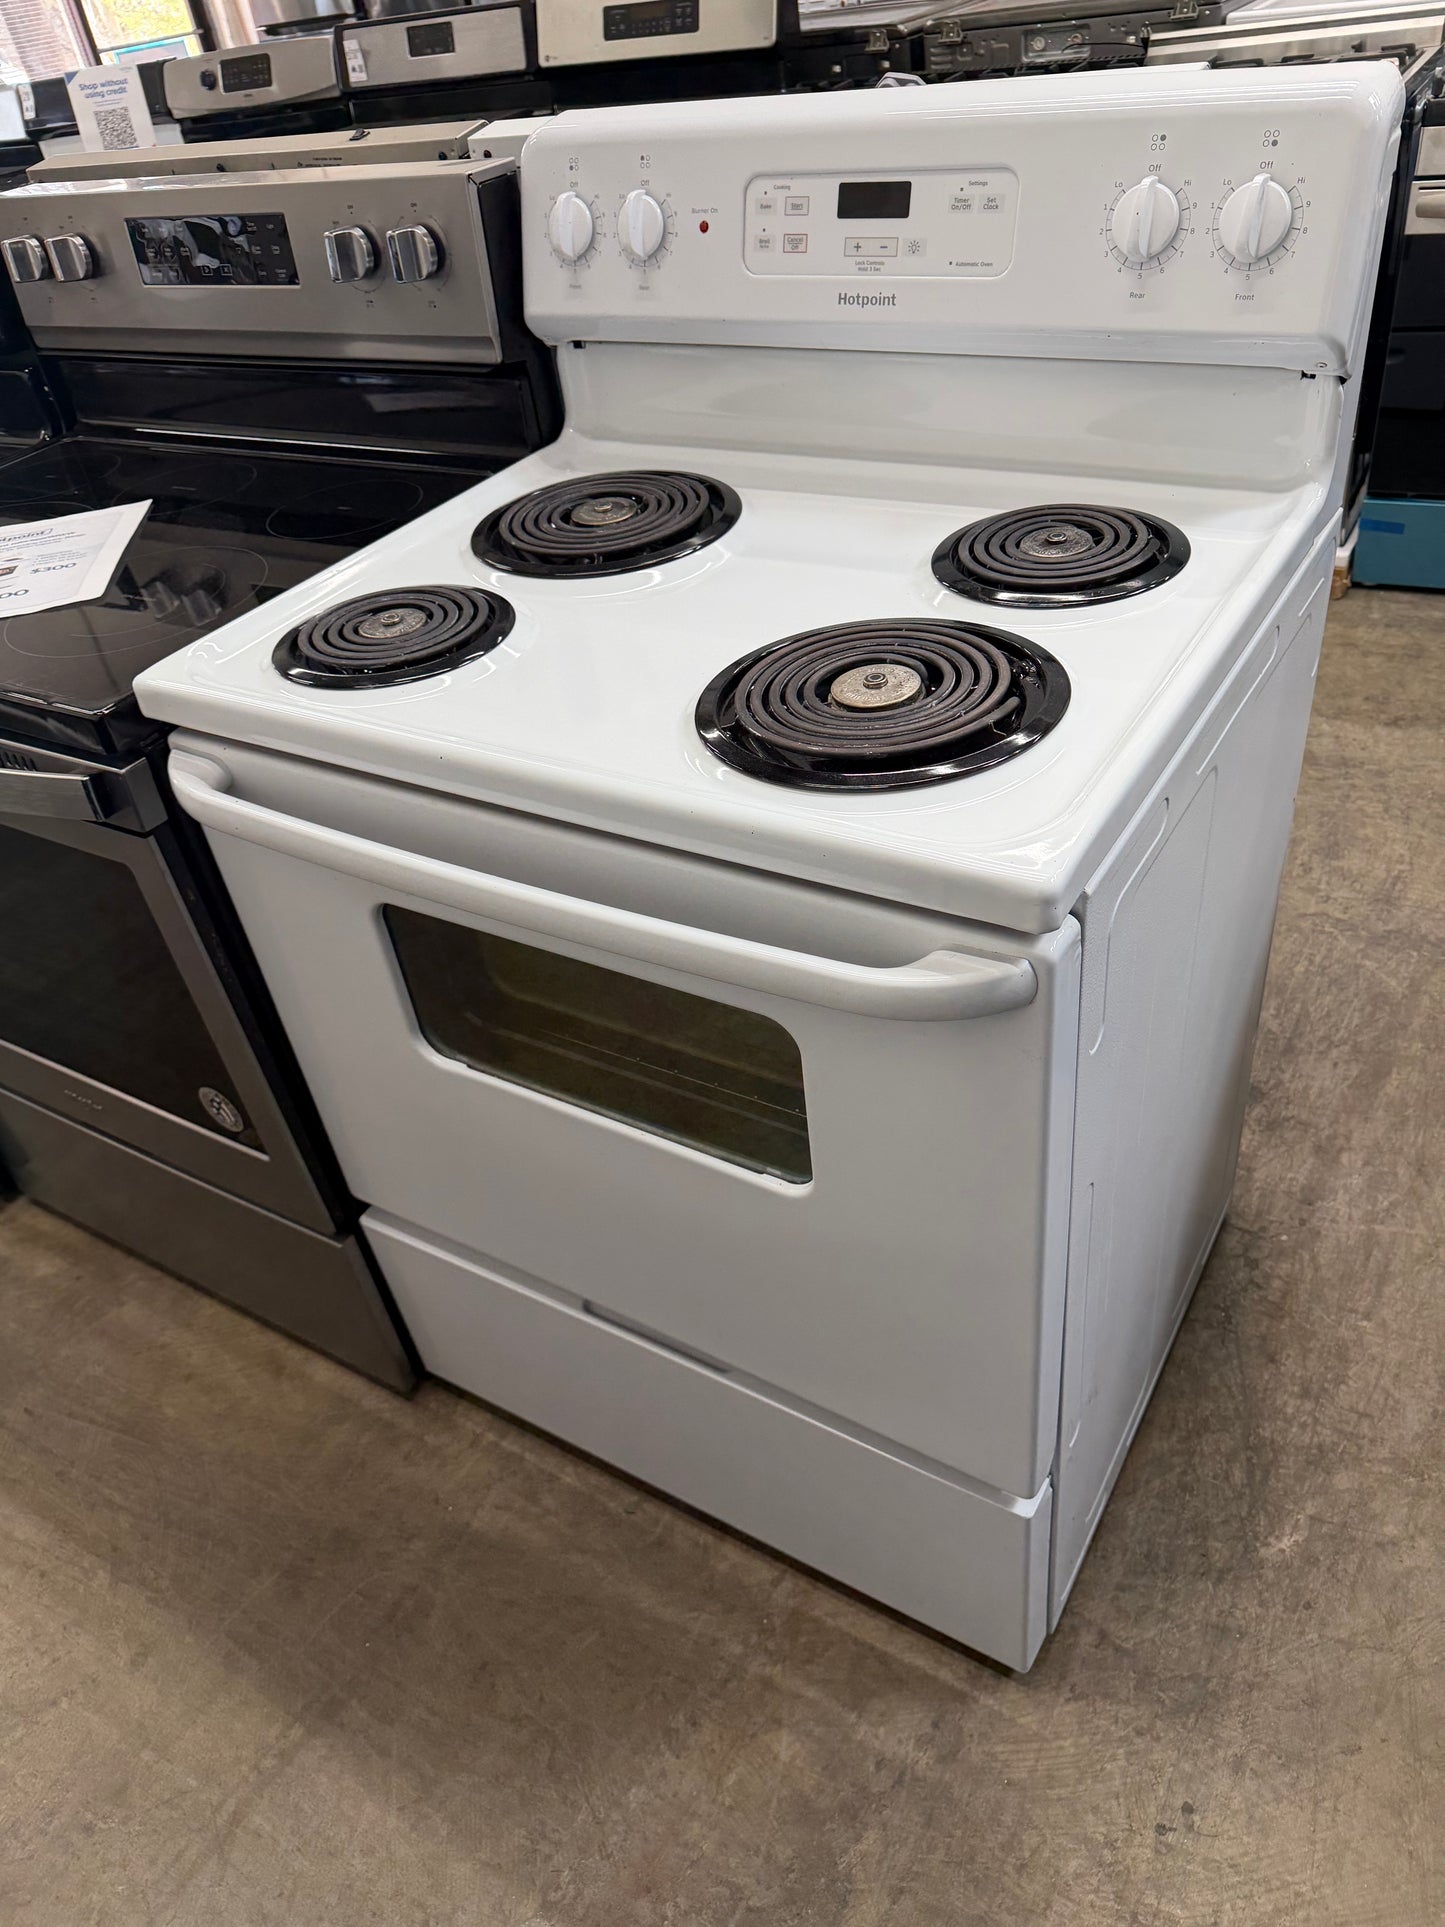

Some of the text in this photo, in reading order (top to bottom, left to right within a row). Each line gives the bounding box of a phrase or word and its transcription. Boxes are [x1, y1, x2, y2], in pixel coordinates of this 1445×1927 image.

[100, 79, 128, 87] without
[106, 87, 128, 95] credit
[1149, 164, 1162, 172] Off
[791, 202, 803, 210] Start
[838, 292, 896, 308] Hotpoint
[30, 562, 77, 574] $300
